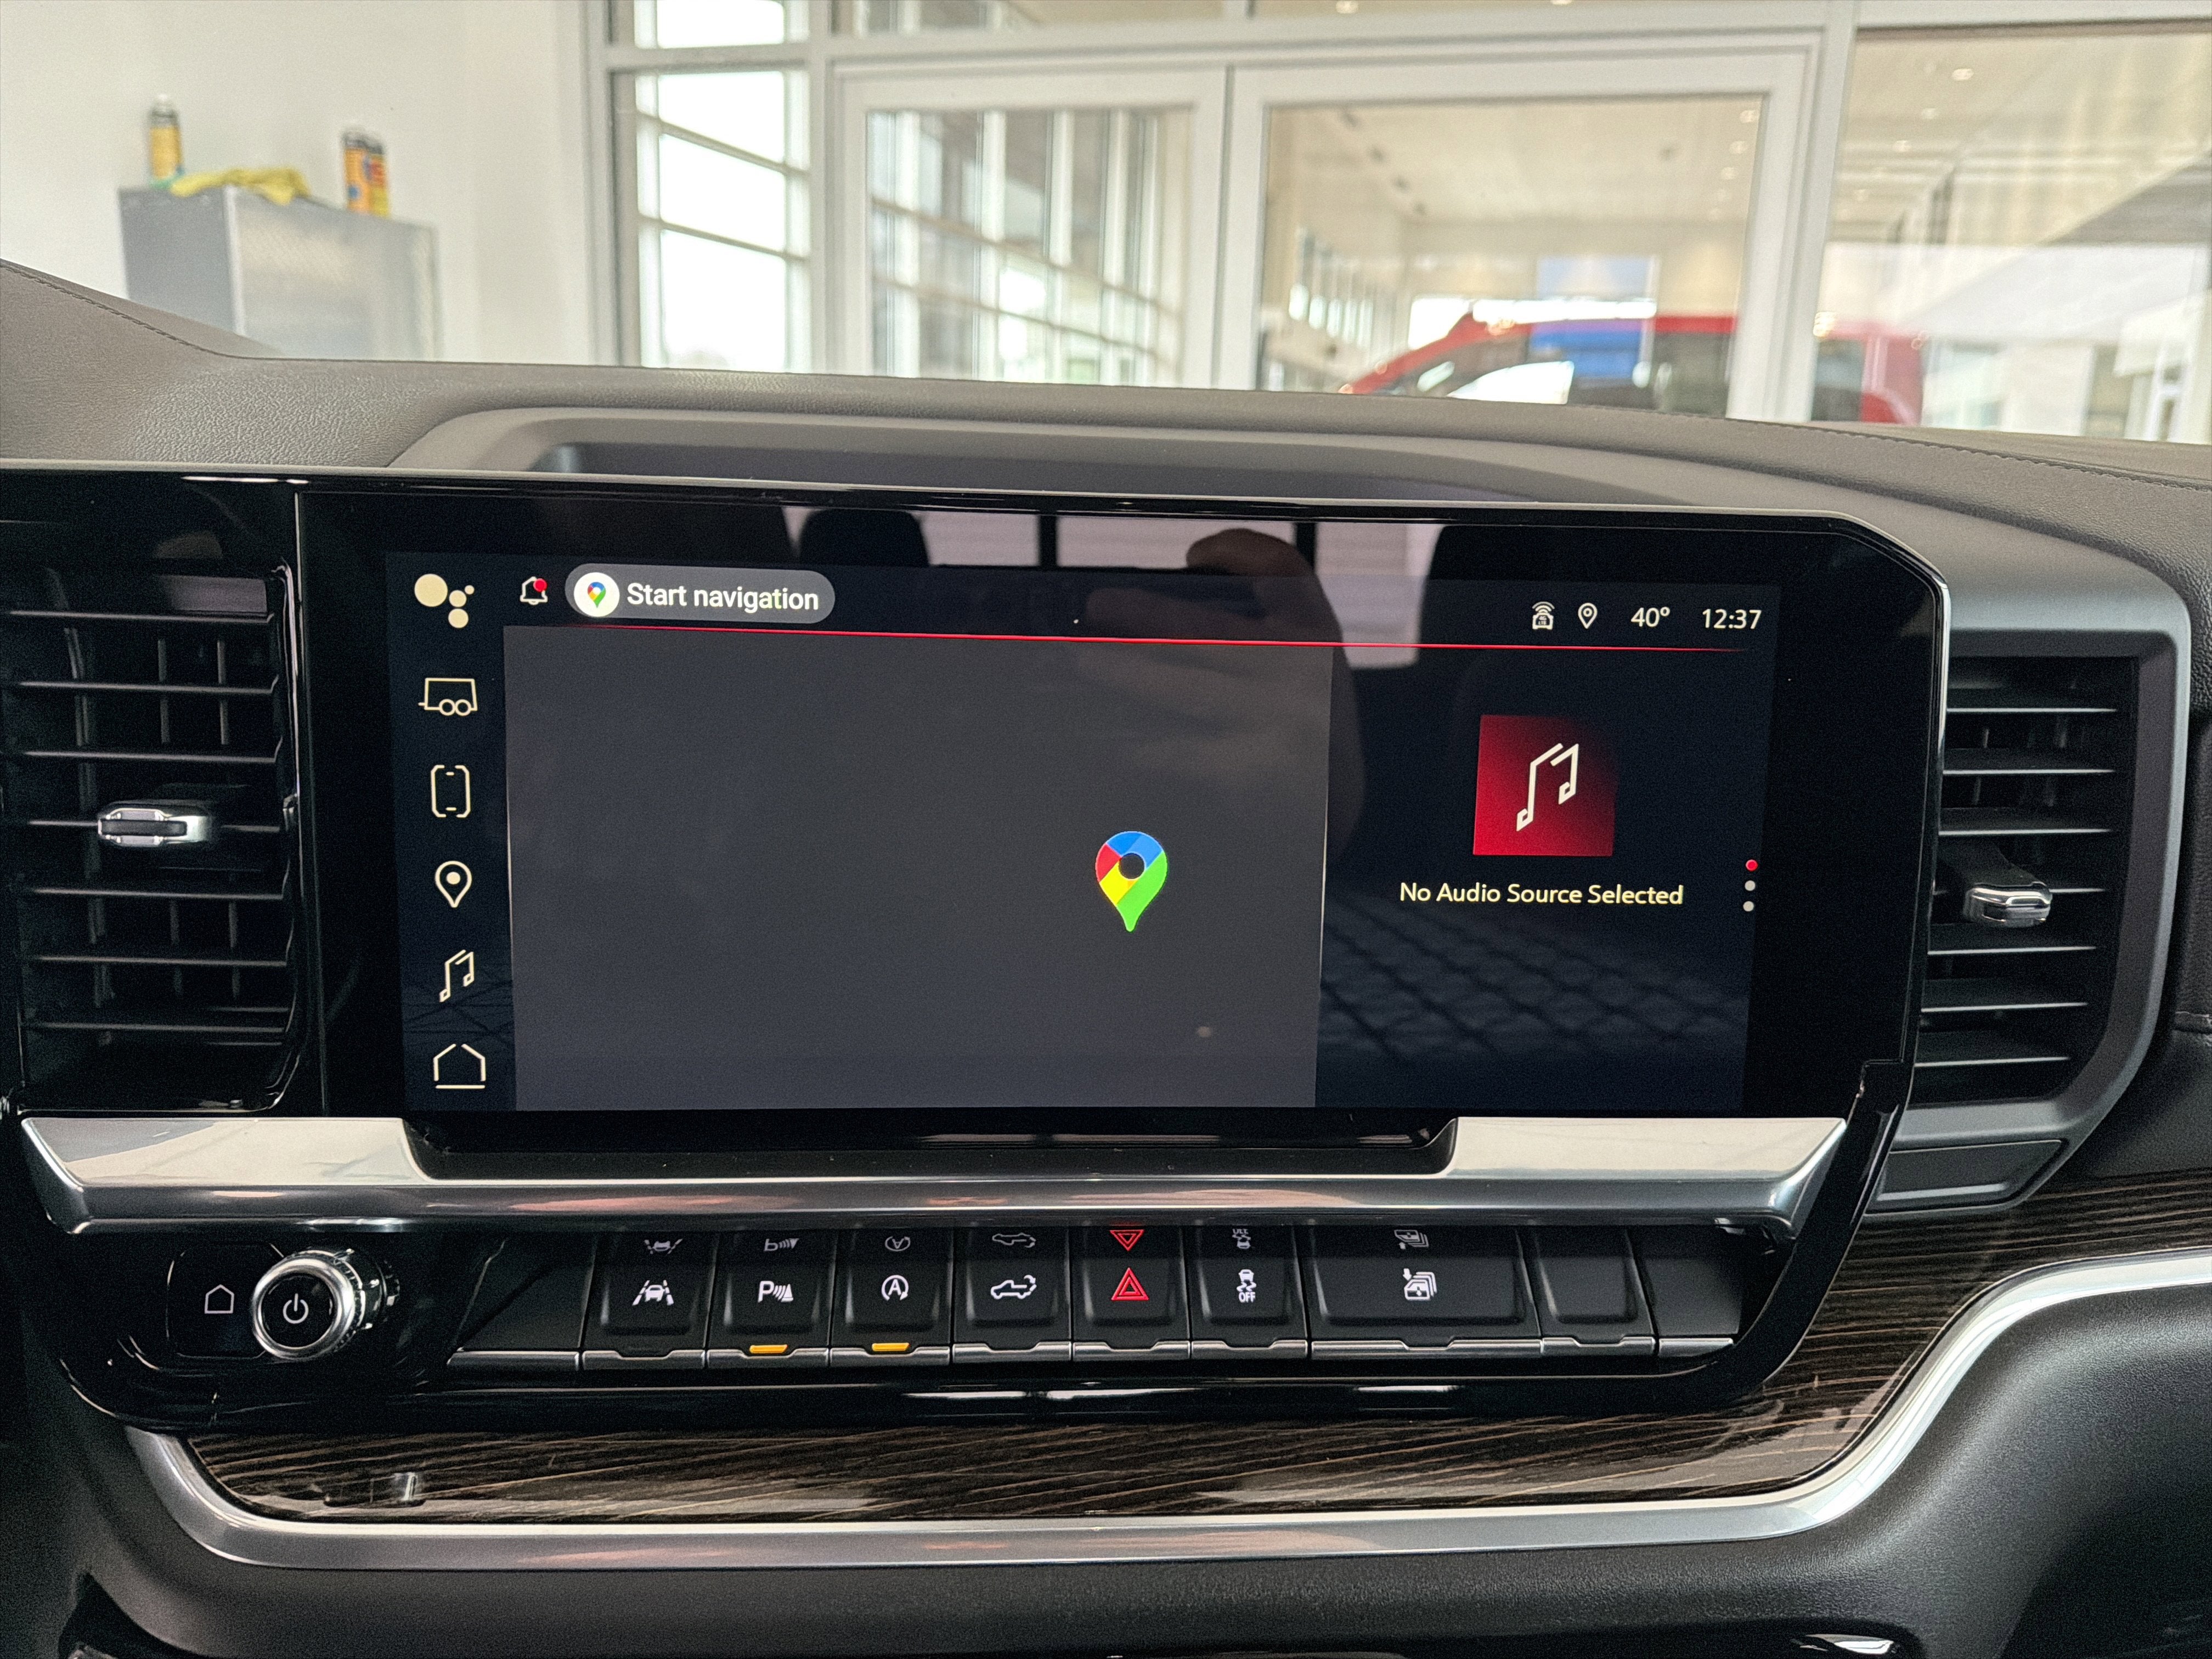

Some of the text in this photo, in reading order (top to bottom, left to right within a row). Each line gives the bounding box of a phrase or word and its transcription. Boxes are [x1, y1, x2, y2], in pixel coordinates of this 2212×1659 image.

[627, 582, 819, 614] Start navigation
[1702, 608, 1762, 629] 12:37
[1400, 882, 1684, 905] No Audio Source Selected
[1238, 1291, 1256, 1304] OFF
